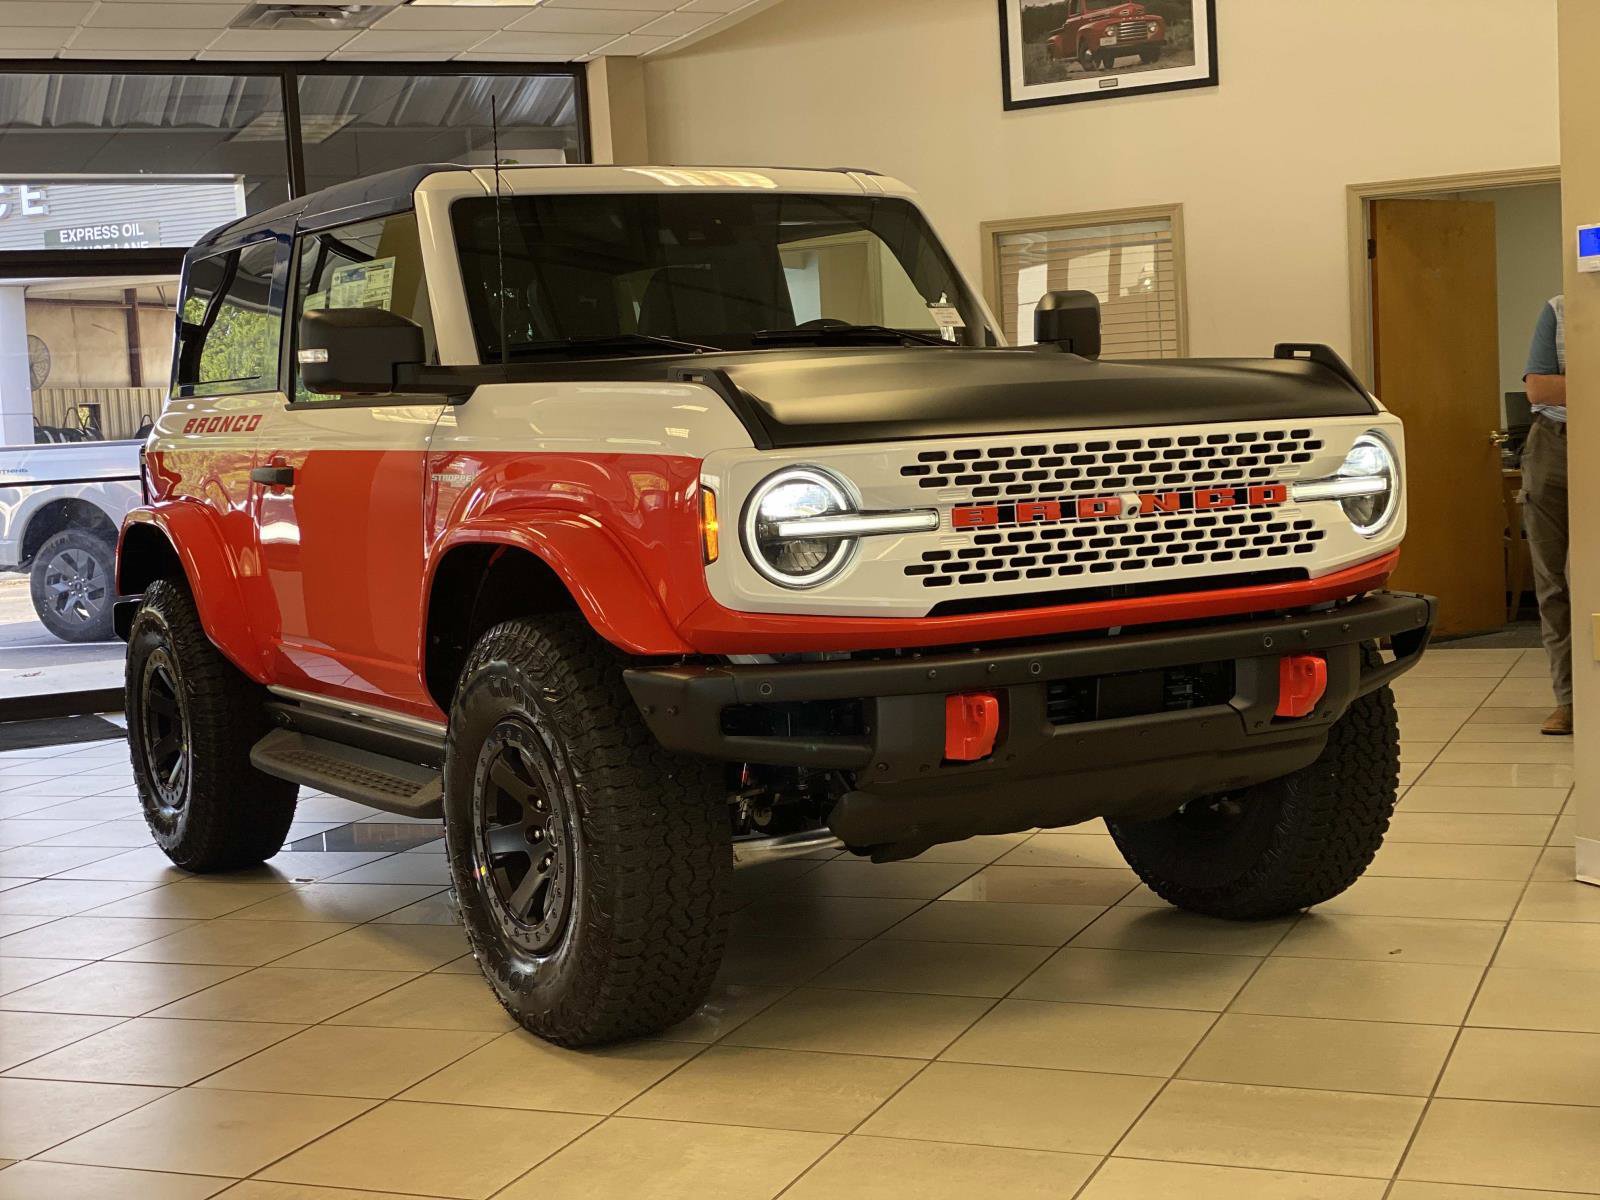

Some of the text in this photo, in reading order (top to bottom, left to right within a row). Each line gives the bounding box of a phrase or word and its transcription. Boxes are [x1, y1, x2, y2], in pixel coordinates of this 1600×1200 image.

[60, 223, 144, 242] EXPRESS OIL
[183, 415, 262, 433] BRONCO
[952, 484, 1286, 527] BRONCO
